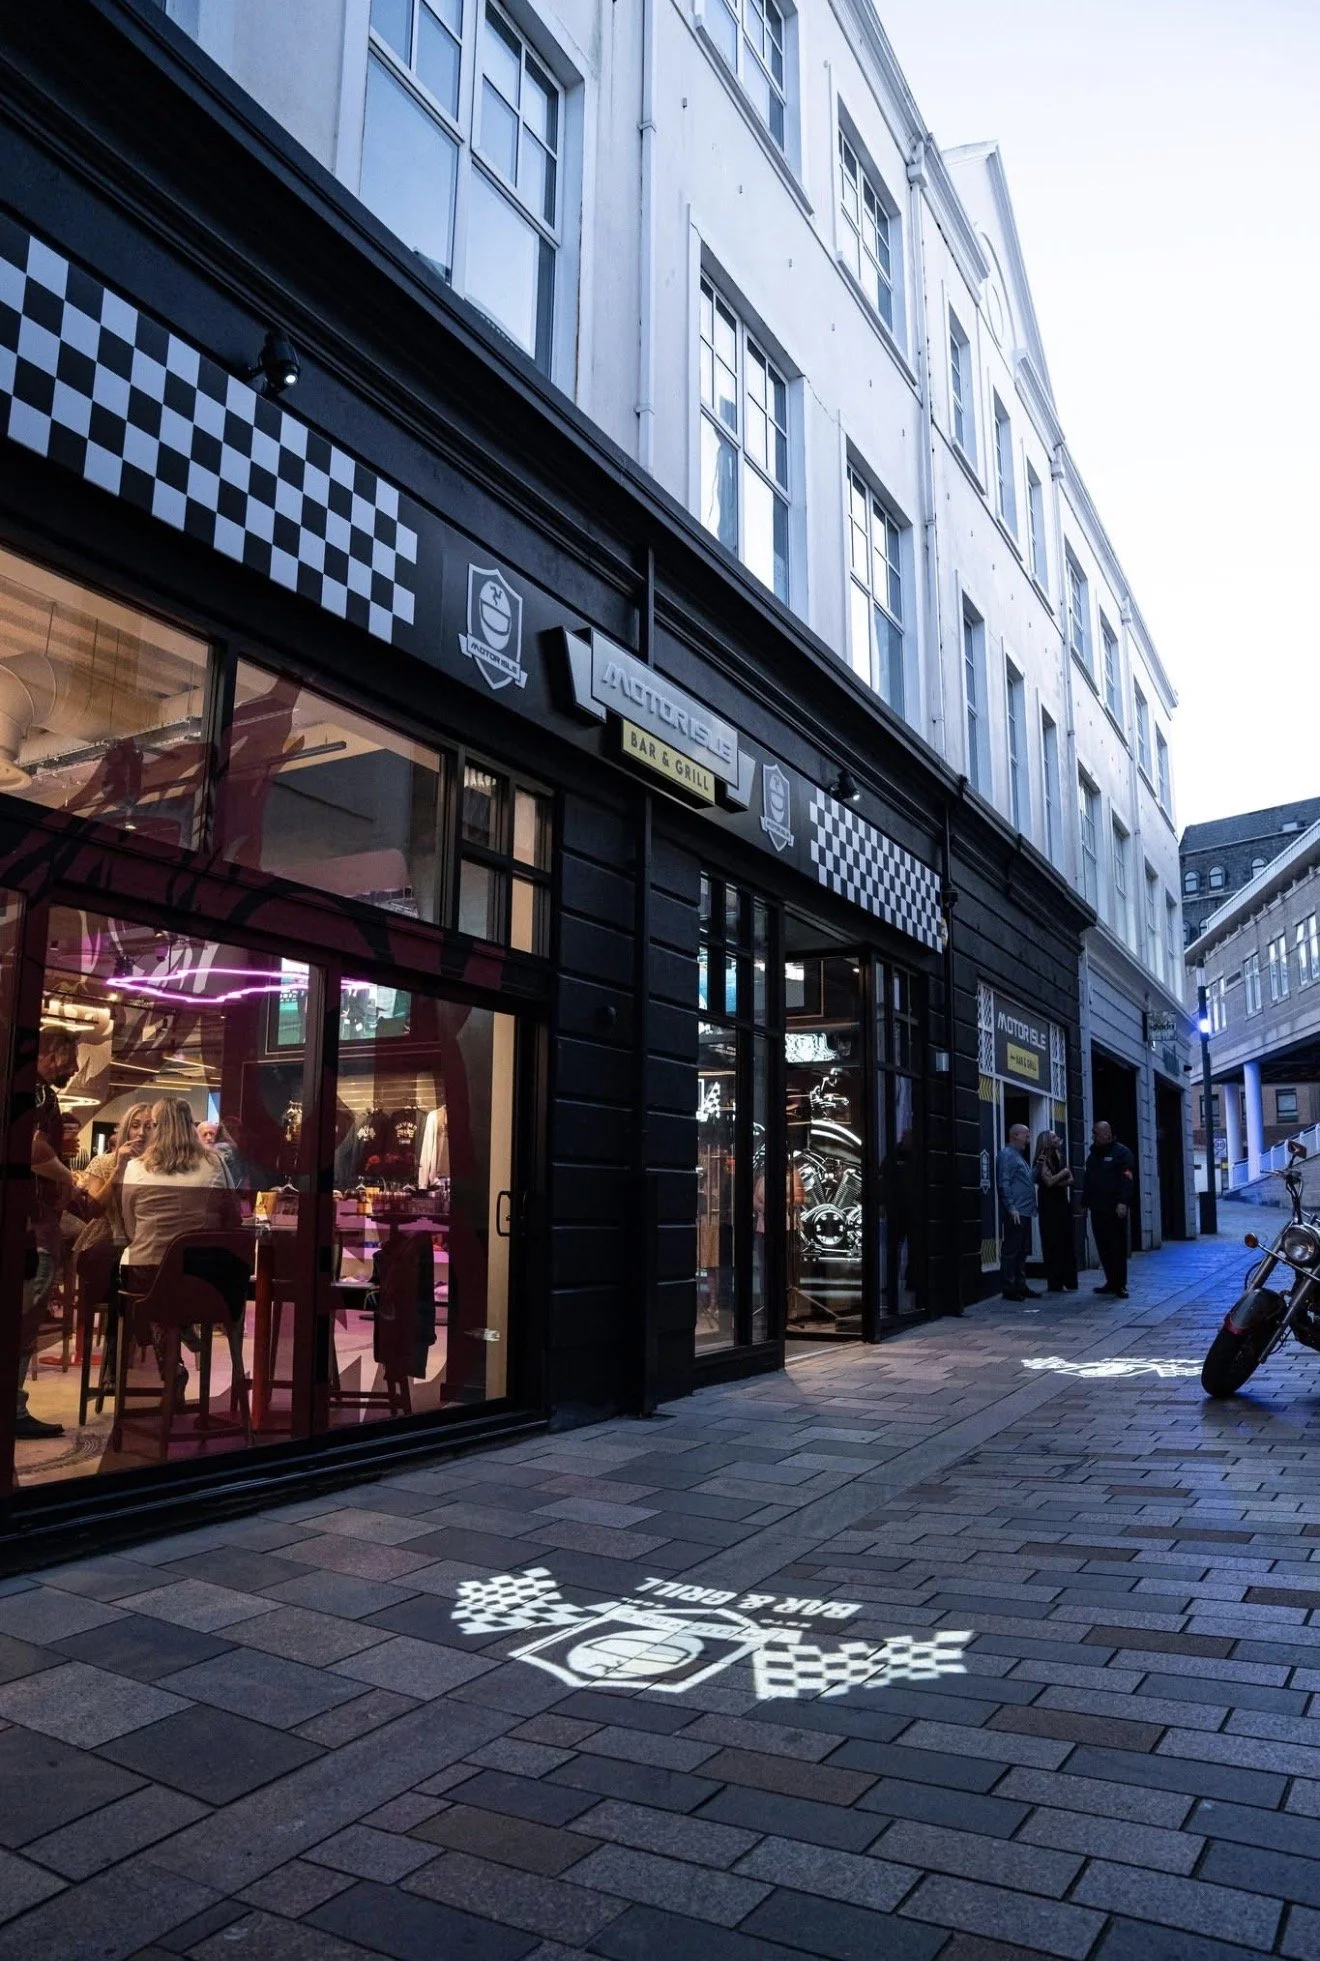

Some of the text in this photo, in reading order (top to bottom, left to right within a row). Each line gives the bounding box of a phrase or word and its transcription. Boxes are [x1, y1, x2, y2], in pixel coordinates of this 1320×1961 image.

[470, 643, 500, 664] MOTOR
[602, 662, 732, 764] MOTOR ISLE
[631, 732, 709, 791] BAR & GRILL
[998, 1012, 1029, 1042] MOTOR
[635, 1577, 738, 1605] GRILL
[737, 1595, 776, 1608] &
[772, 1597, 863, 1619] BAR
